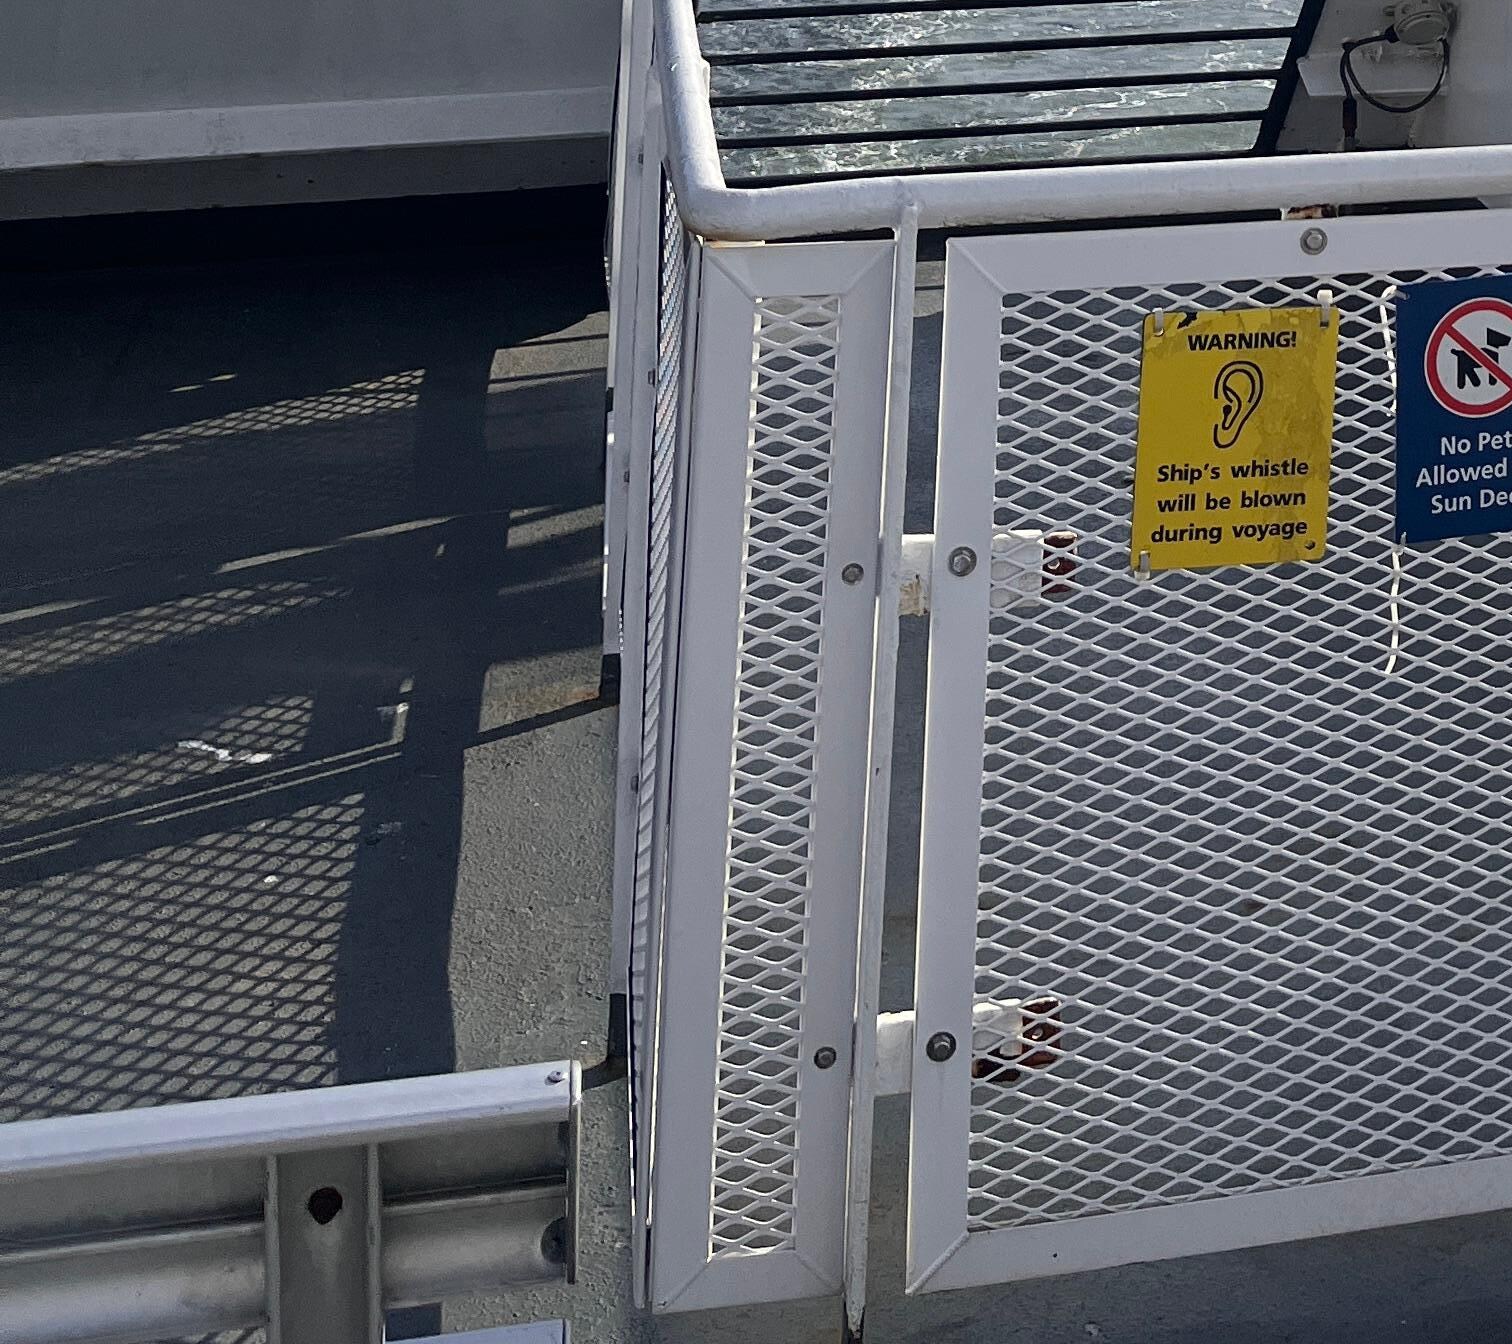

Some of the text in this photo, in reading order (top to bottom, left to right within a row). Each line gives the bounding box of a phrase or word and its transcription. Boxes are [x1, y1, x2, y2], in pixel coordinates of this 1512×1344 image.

[1187, 330, 1297, 352] WARNING!
[1440, 435, 1472, 456] No
[1157, 457, 1309, 485] Ship’s whistle
[1415, 456, 1508, 488] Allowed
[1157, 489, 1306, 513] will be blown
[1431, 494, 1472, 514] Sun
[1150, 521, 1308, 545] during voyage
